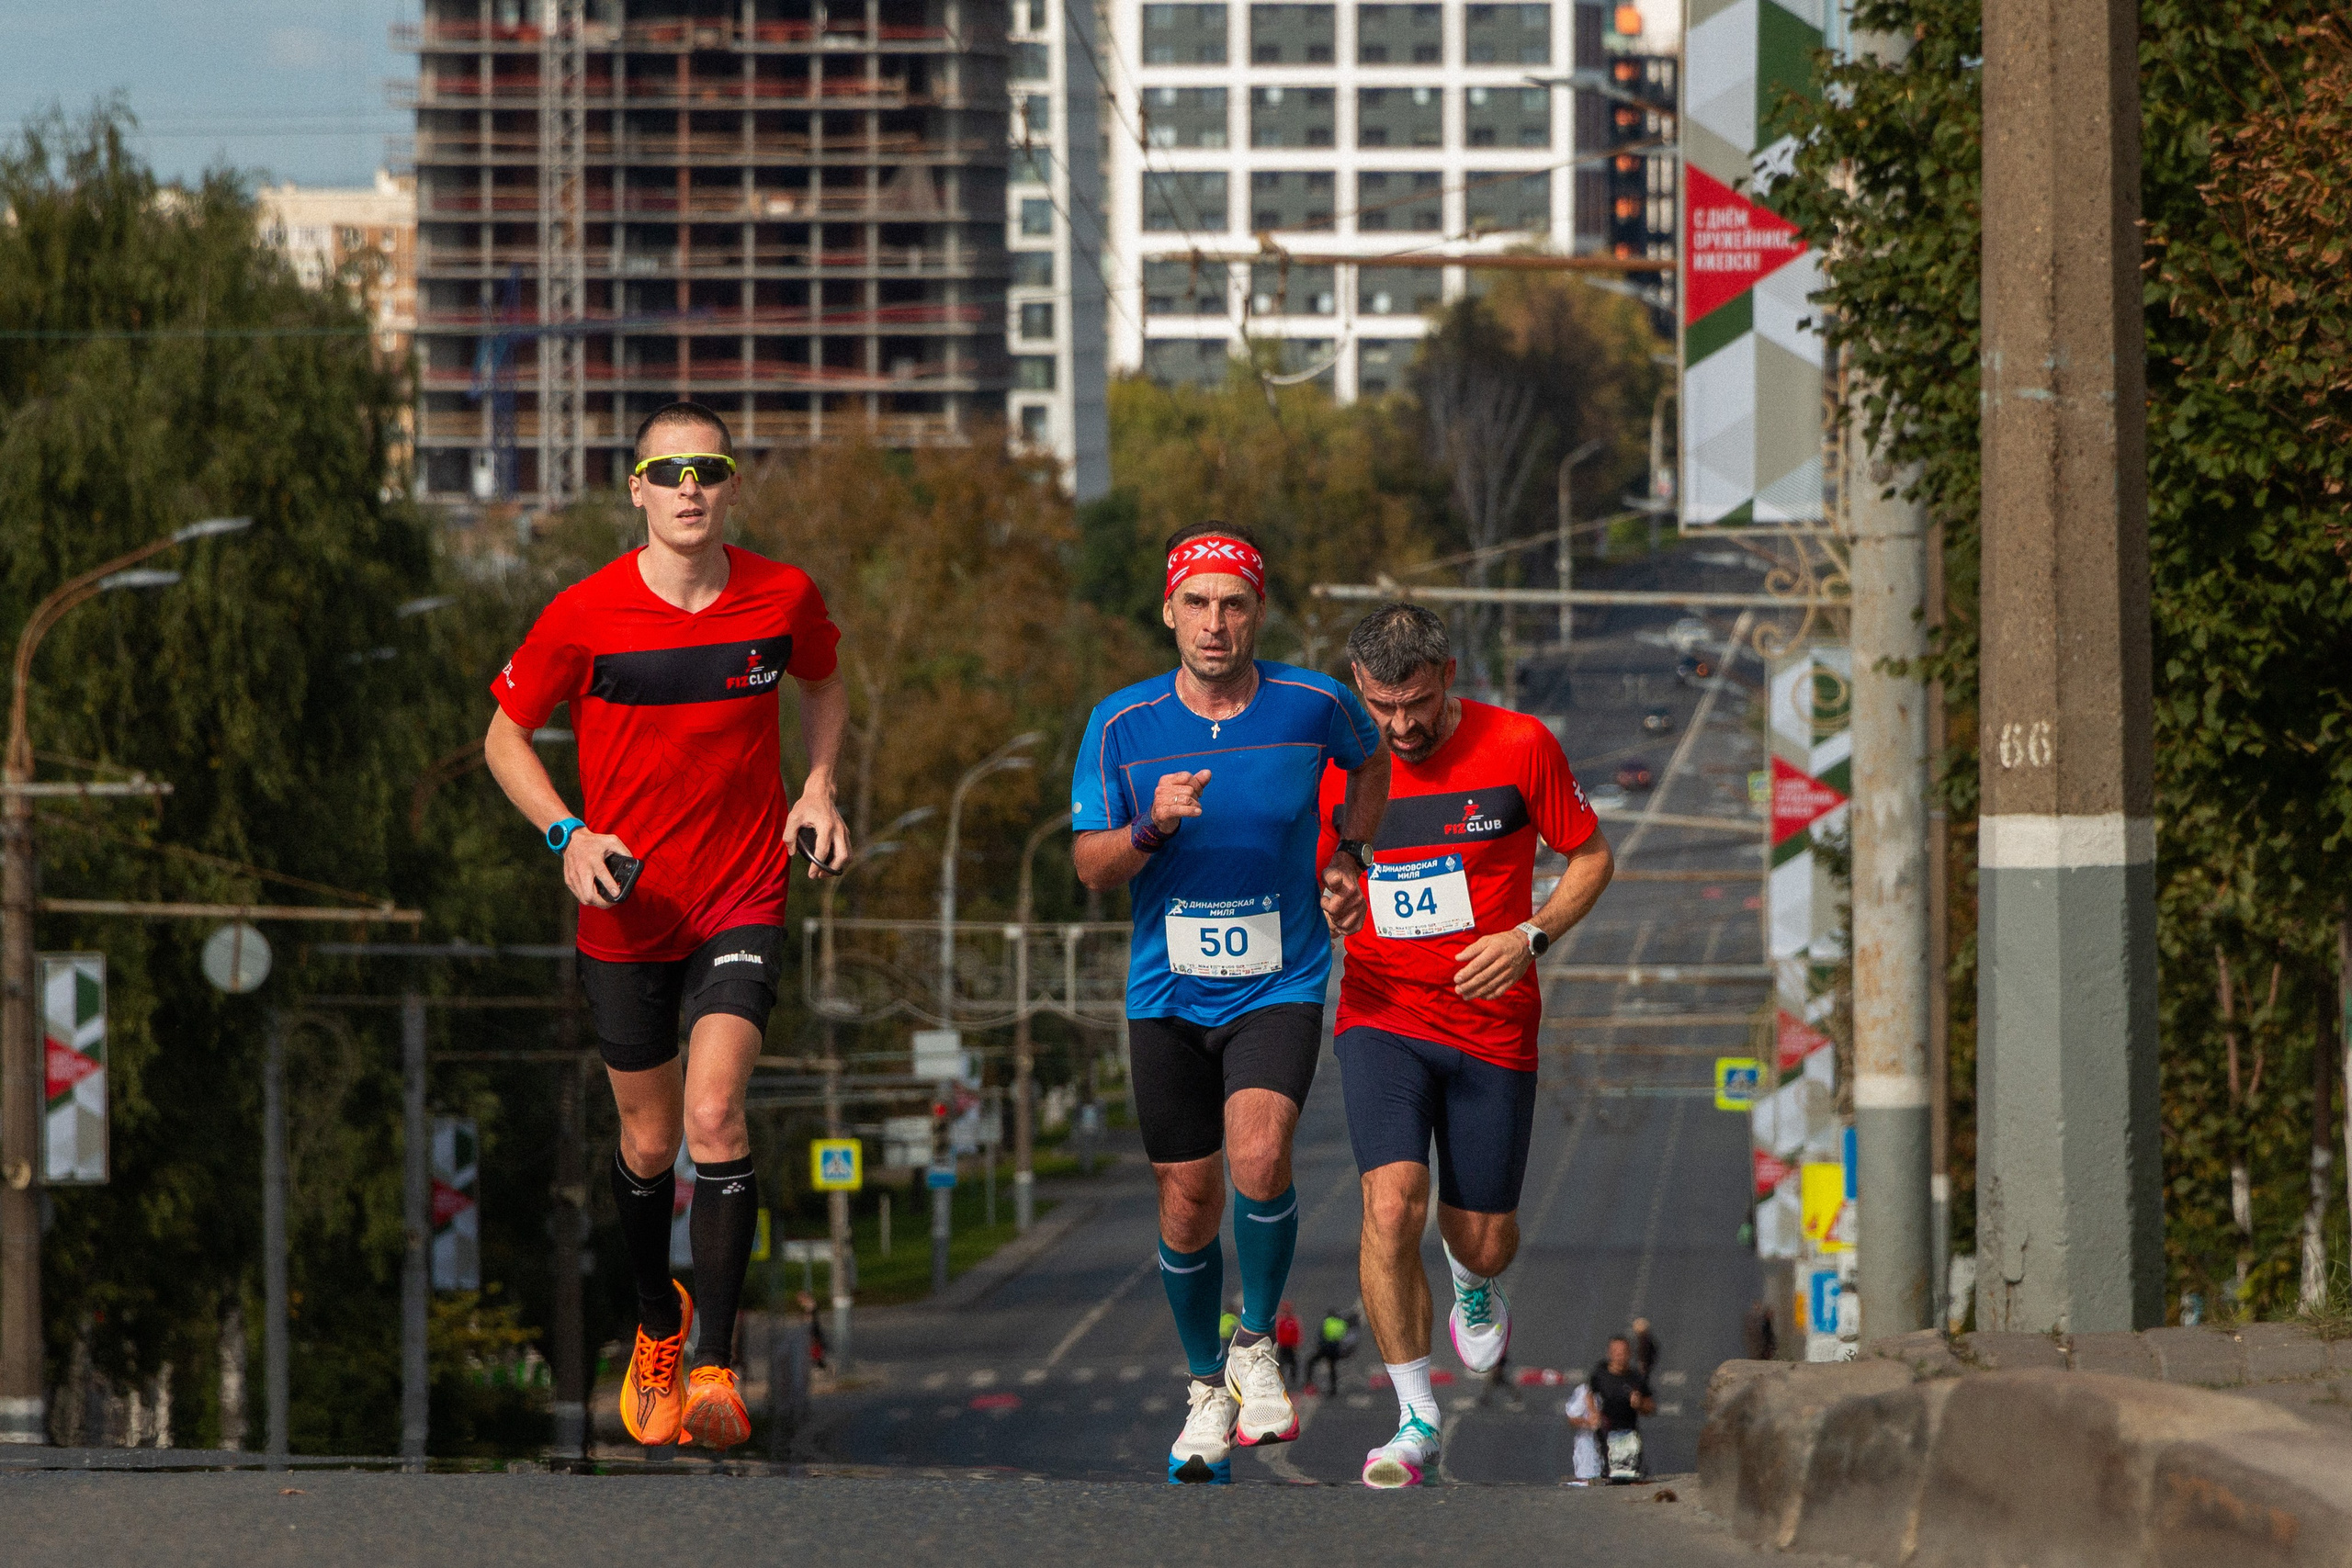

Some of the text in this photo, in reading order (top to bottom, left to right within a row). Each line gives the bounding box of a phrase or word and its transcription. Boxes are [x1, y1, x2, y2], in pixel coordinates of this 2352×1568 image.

[1693, 208, 1704, 228] С
[1693, 252, 1761, 271] ИЖЕВСК!
[1999, 720, 2052, 768] 66
[1443, 819, 1502, 835] FIZCLUB
[1382, 860, 1438, 874] ДИНАМОВСКАЯ
[1397, 871, 1420, 880] МИЛЯ
[1189, 898, 1255, 909] ДИНАМОВСКАЯ
[1394, 886, 1438, 919] 84
[1209, 908, 1235, 917] МИЛЯ
[1200, 926, 1249, 957] 50
[714, 950, 763, 967] IRONMAN
